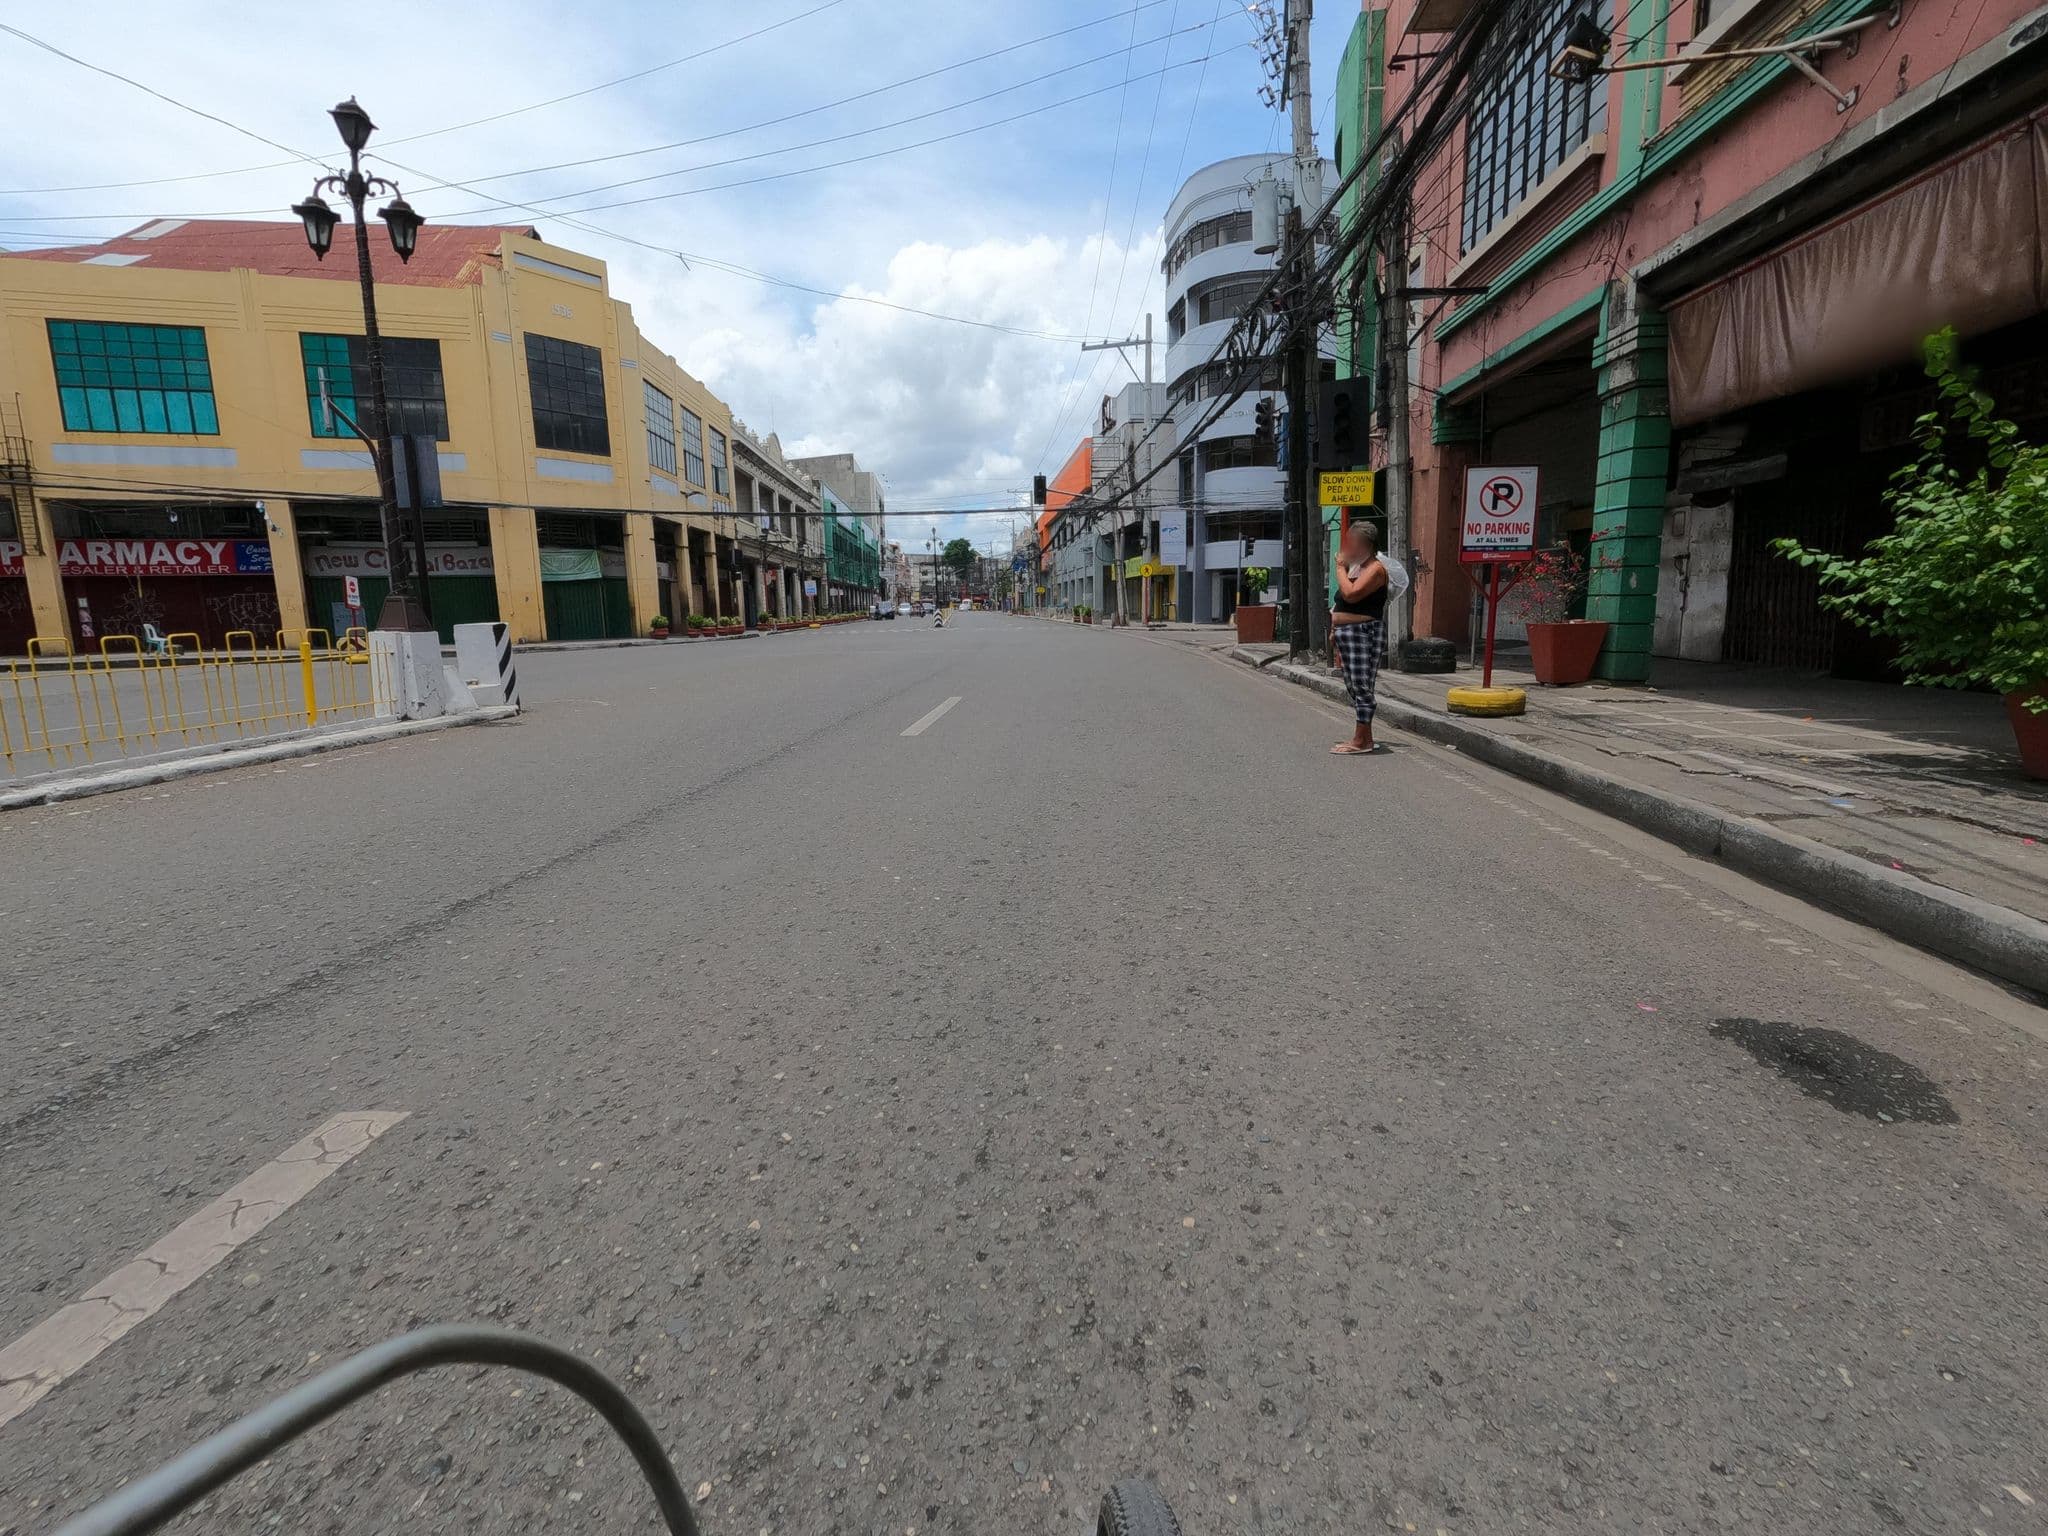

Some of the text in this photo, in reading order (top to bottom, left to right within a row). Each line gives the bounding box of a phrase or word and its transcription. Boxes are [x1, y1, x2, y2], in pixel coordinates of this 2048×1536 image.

[1322, 475, 1371, 484] SLOW DOWN
[1327, 485, 1365, 493] PED XING
[1331, 494, 1361, 502] AHEAD
[1467, 522, 1530, 535] NO PARKING
[0, 541, 227, 565] PARMACY
[4, 565, 230, 575] WESALER & RETAILER
